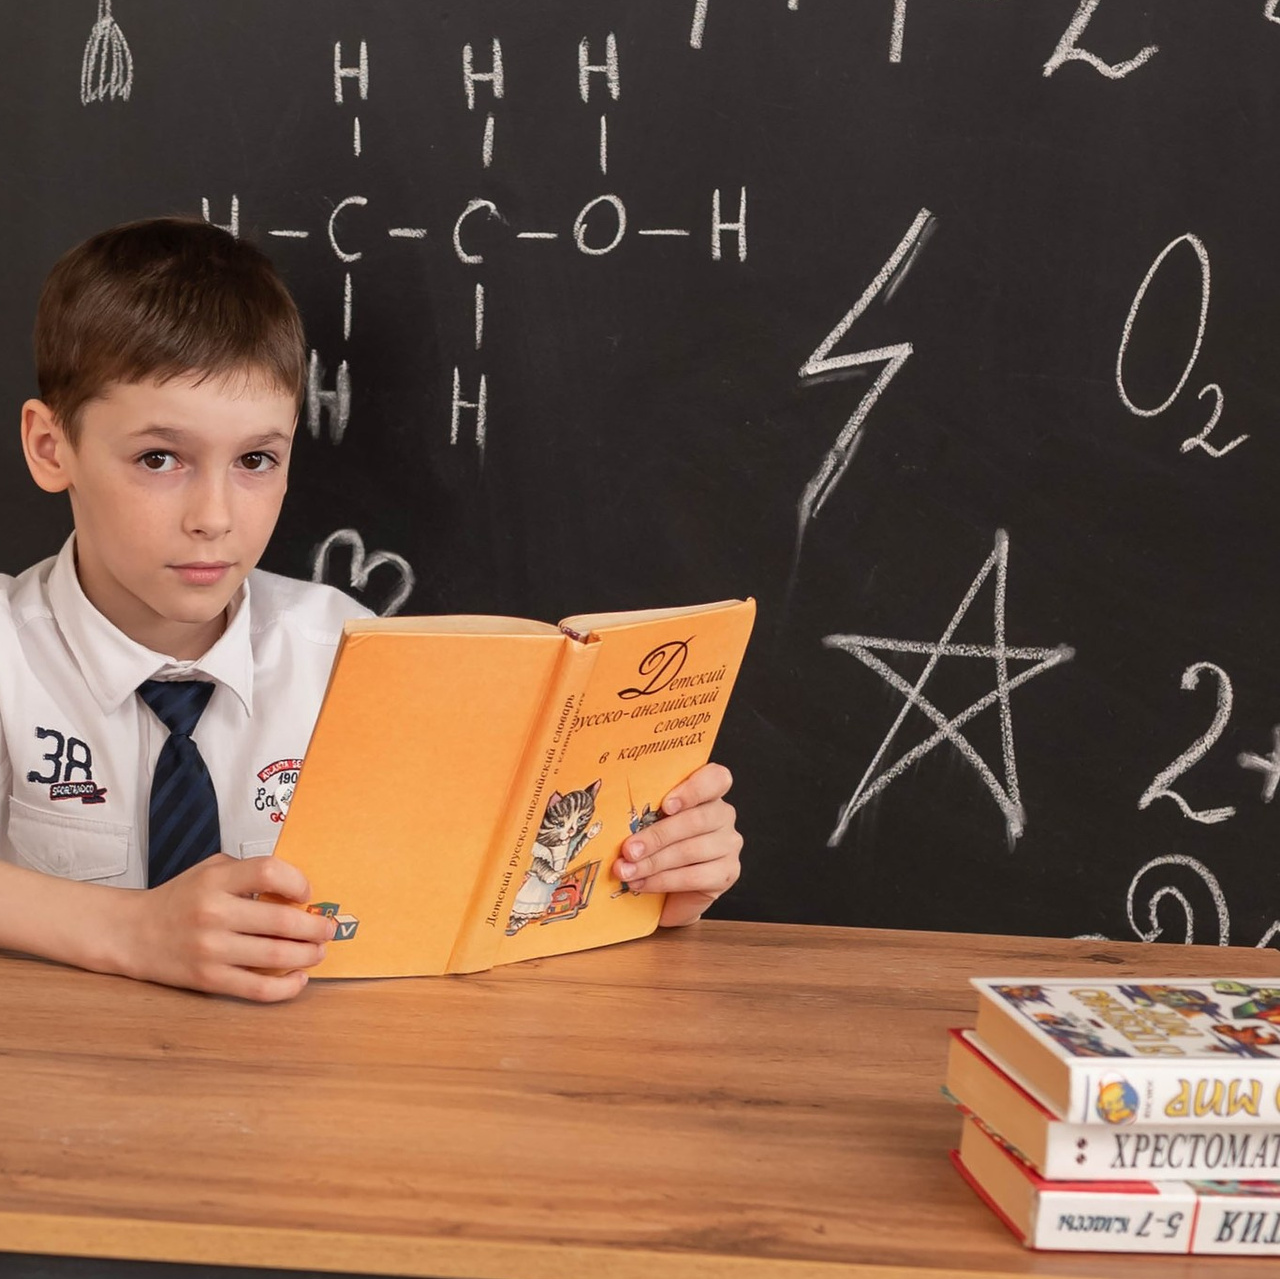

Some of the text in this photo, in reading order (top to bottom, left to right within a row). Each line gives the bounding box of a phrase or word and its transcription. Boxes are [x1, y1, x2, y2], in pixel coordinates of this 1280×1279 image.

[616, 634, 727, 700] Детский
[653, 711, 712, 734] словарь
[598, 730, 706, 764] в картинках
[485, 871, 513, 928] Детский
[509, 747, 557, 868] русско-английский
[552, 694, 575, 744] словарь
[1164, 1078, 1263, 1118] МИР
[1057, 1211, 1184, 1239] 5-7 классы
